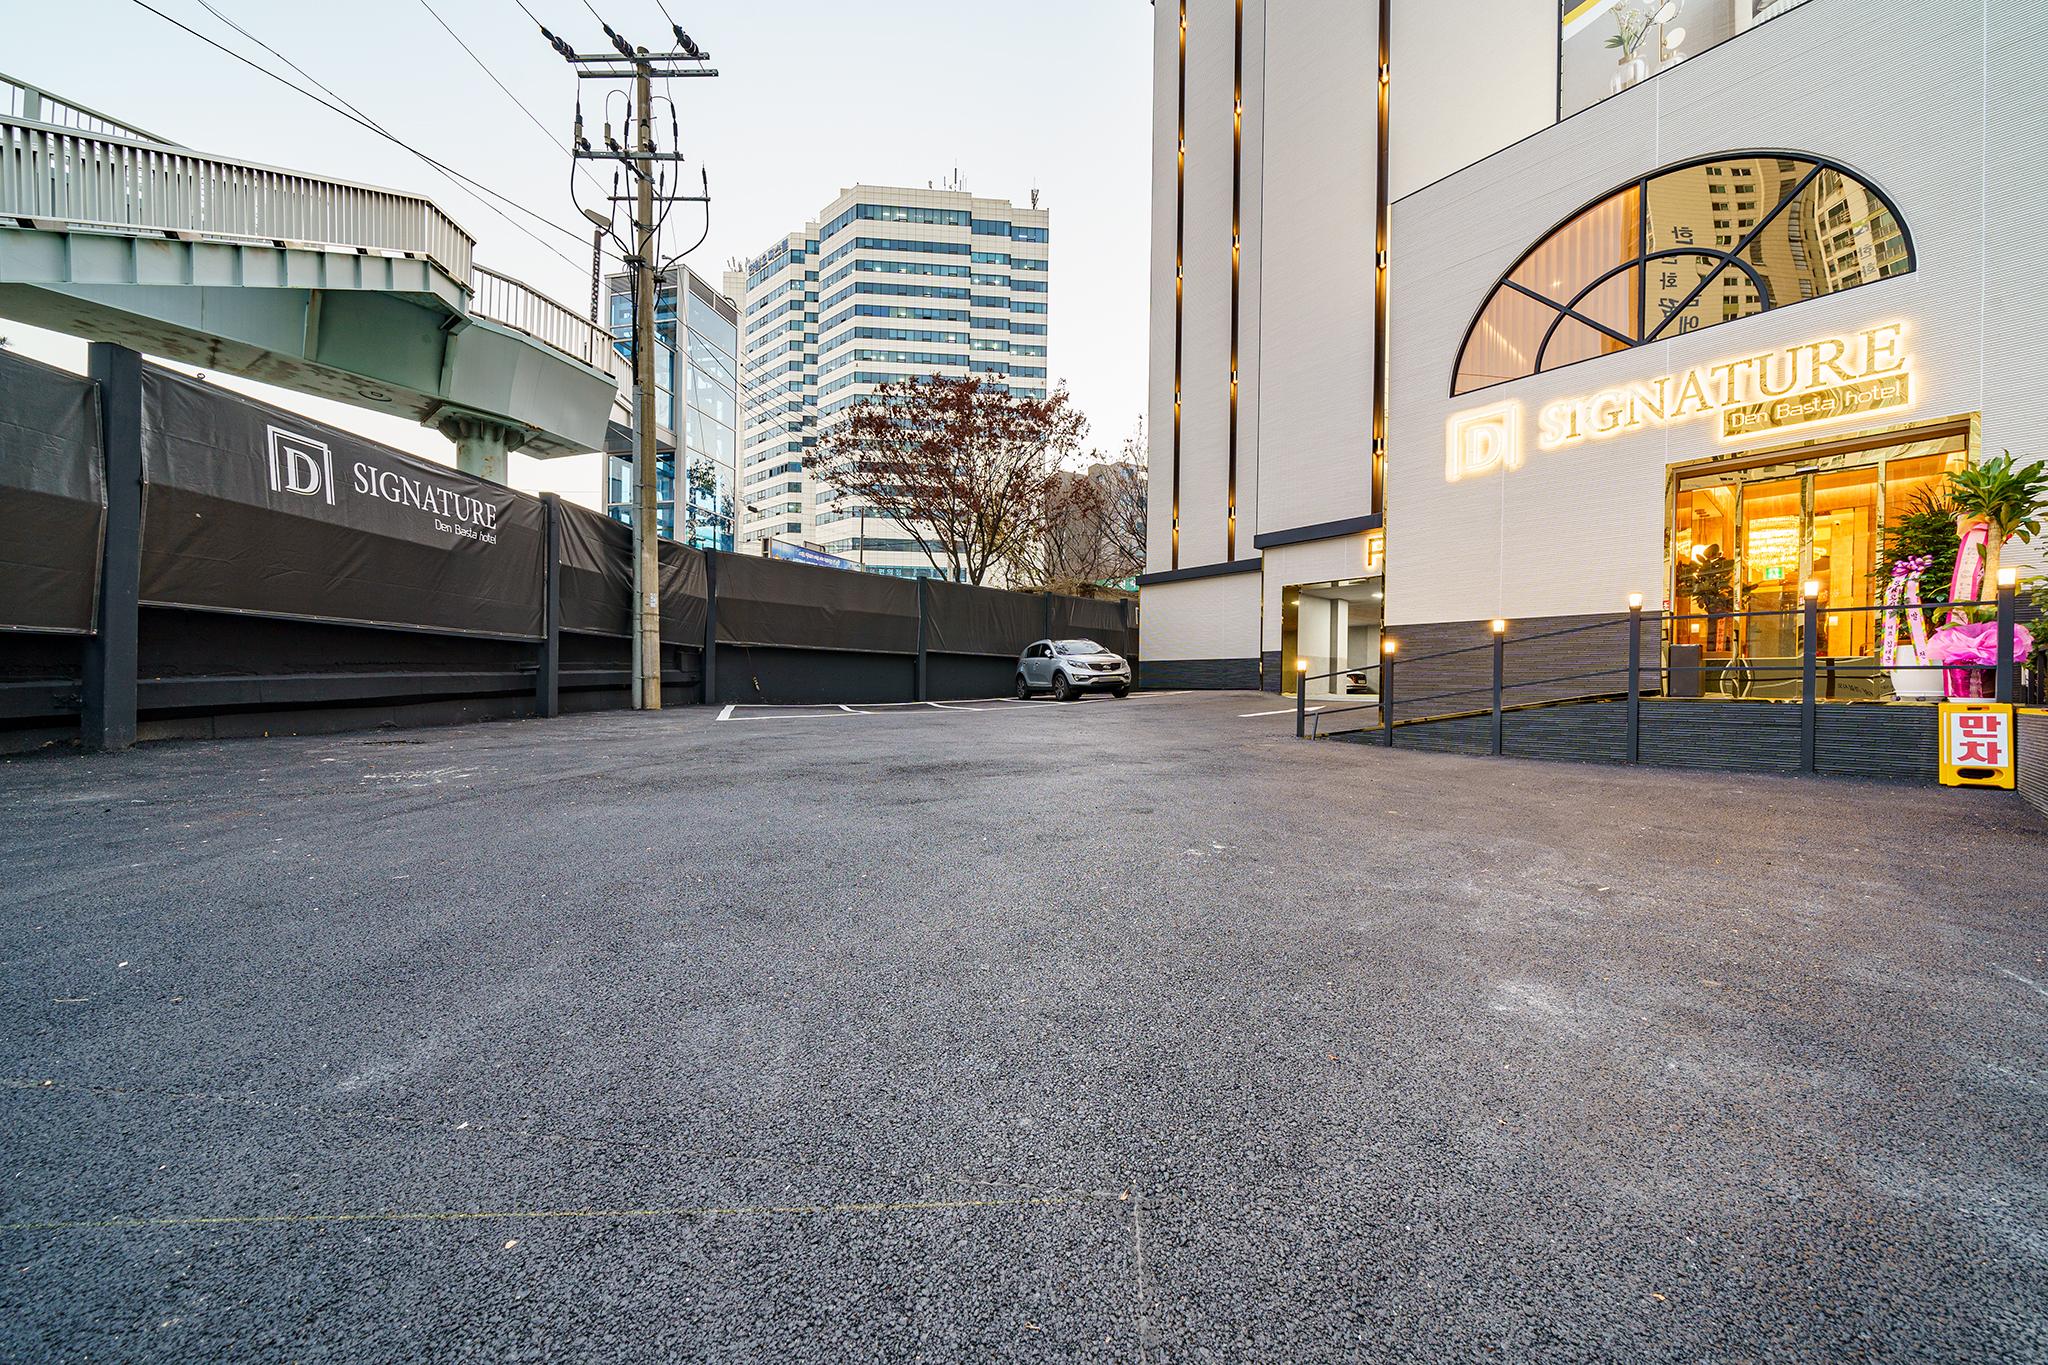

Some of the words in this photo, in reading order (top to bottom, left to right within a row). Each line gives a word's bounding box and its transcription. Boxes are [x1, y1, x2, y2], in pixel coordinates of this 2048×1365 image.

[1539, 324, 1907, 448] SIGNATURE
[1731, 411, 1768, 428] Den
[1776, 398, 1836, 420] Basta
[1845, 382, 1901, 407] hotel
[353, 462, 497, 530] SIGNATURE
[434, 518, 452, 533] Den
[455, 523, 477, 539] Basta
[478, 531, 497, 545] hotel
[1956, 715, 2003, 765] 만차
